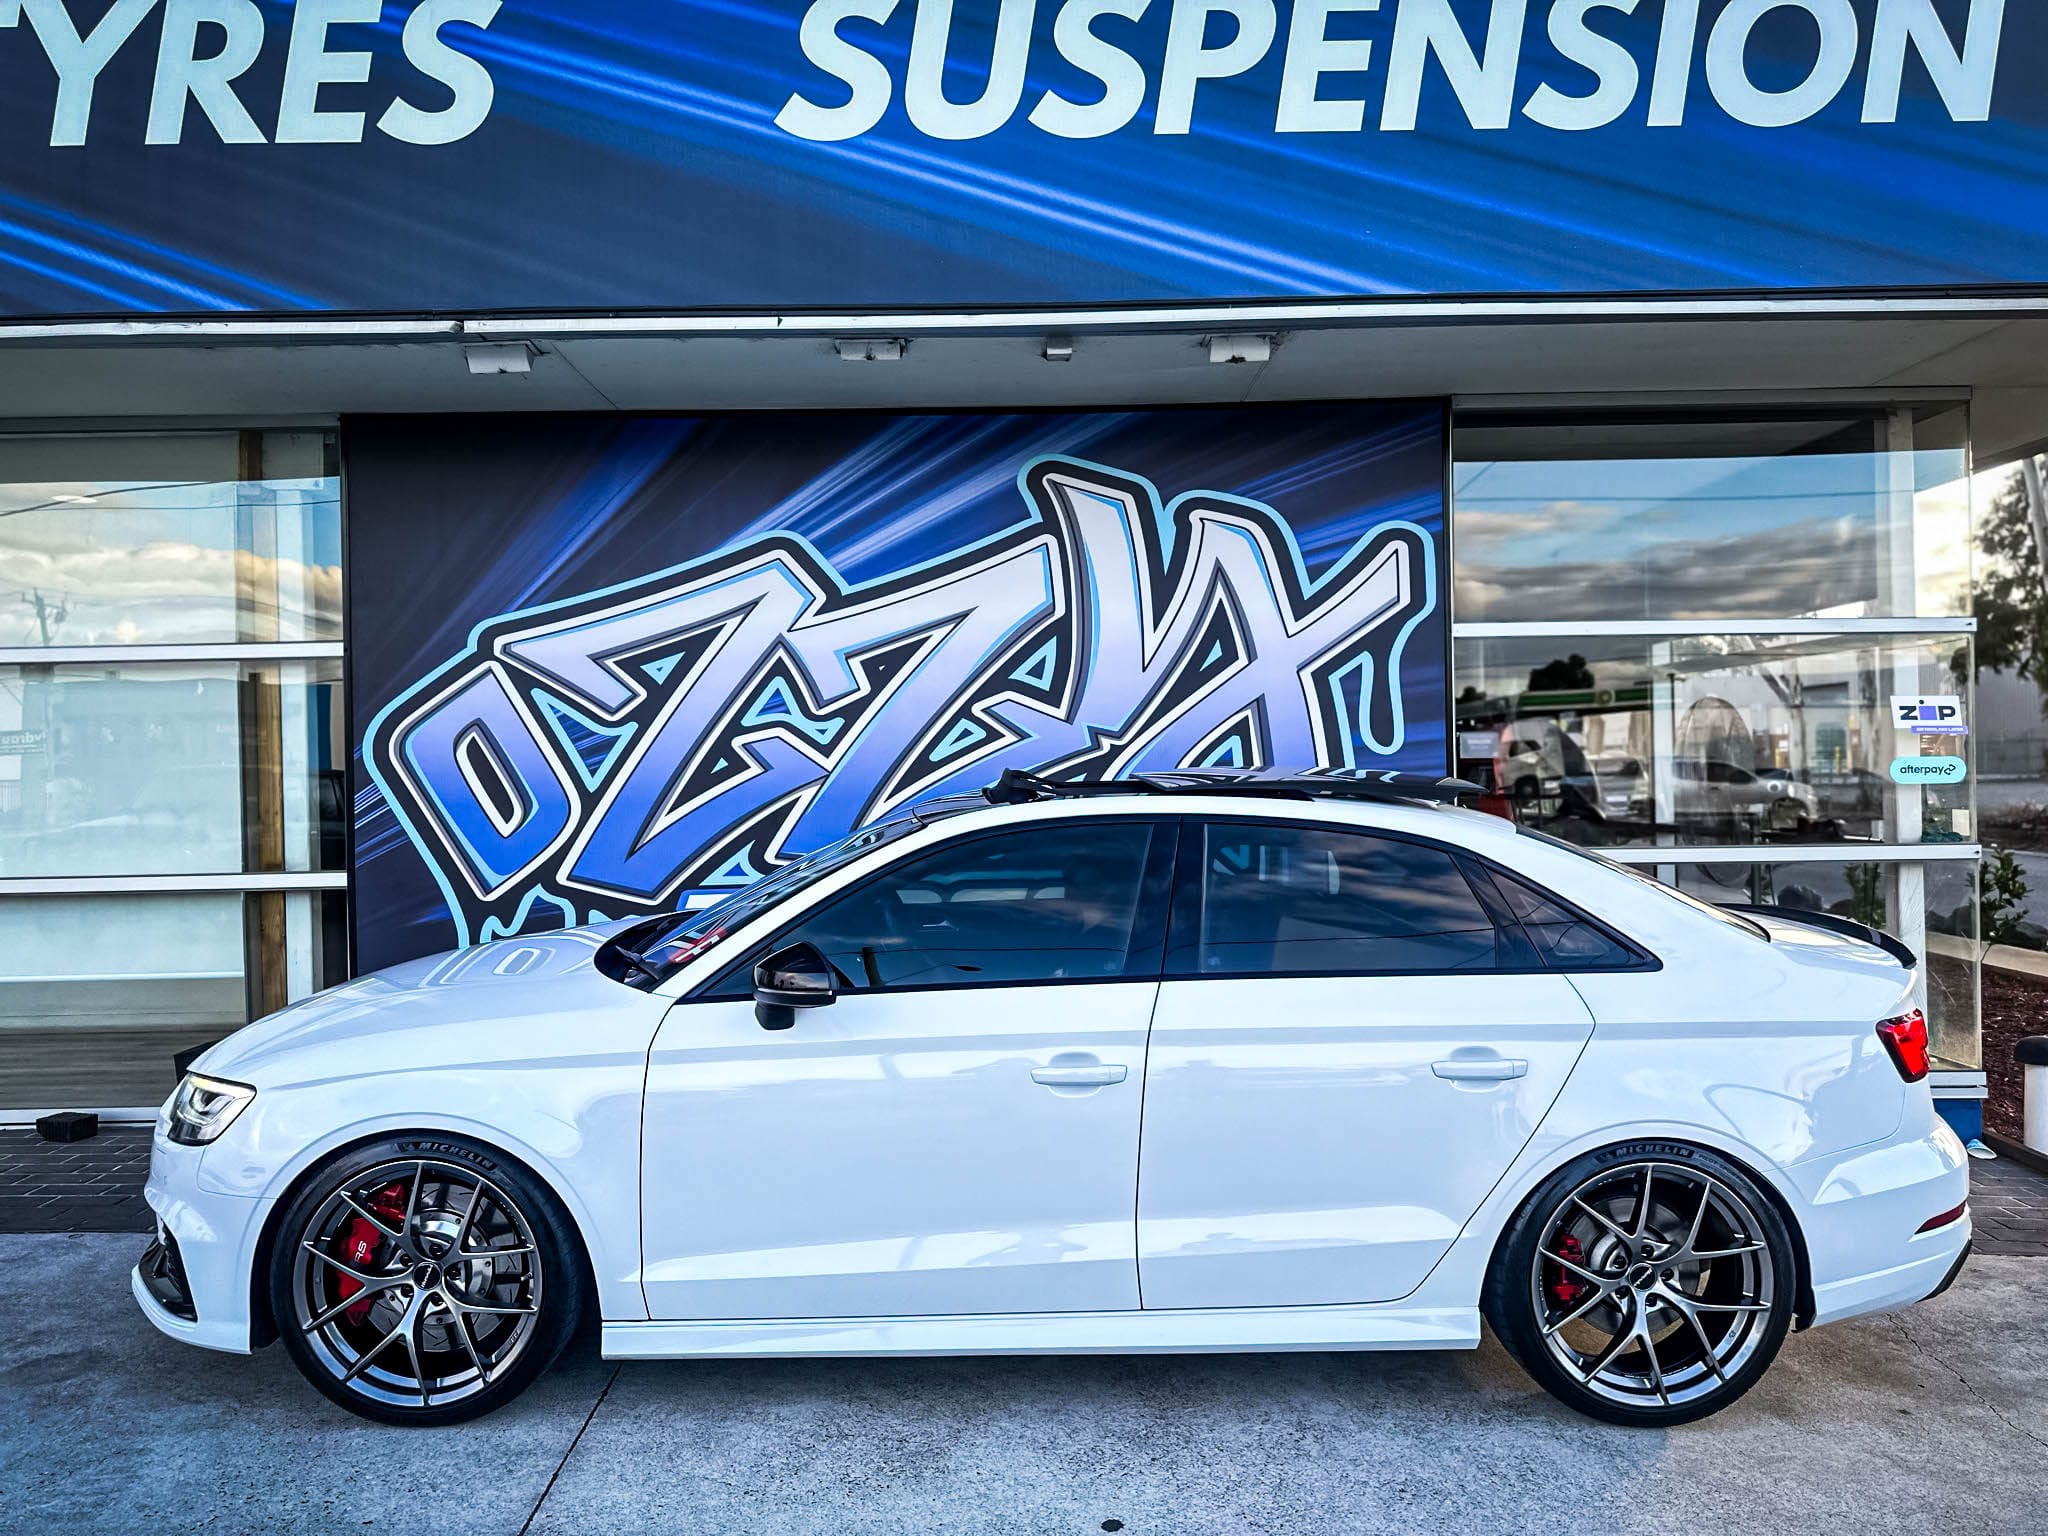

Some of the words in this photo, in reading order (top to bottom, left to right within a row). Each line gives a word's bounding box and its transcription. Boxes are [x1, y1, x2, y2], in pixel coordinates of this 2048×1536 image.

[0, 0, 502, 147] YRES
[773, 0, 2005, 142] SUSPENSION
[1899, 764, 1945, 776] afterpay
[418, 1141, 494, 1170] MICHELIN
[1615, 1144, 1690, 1158] MICHELIN
